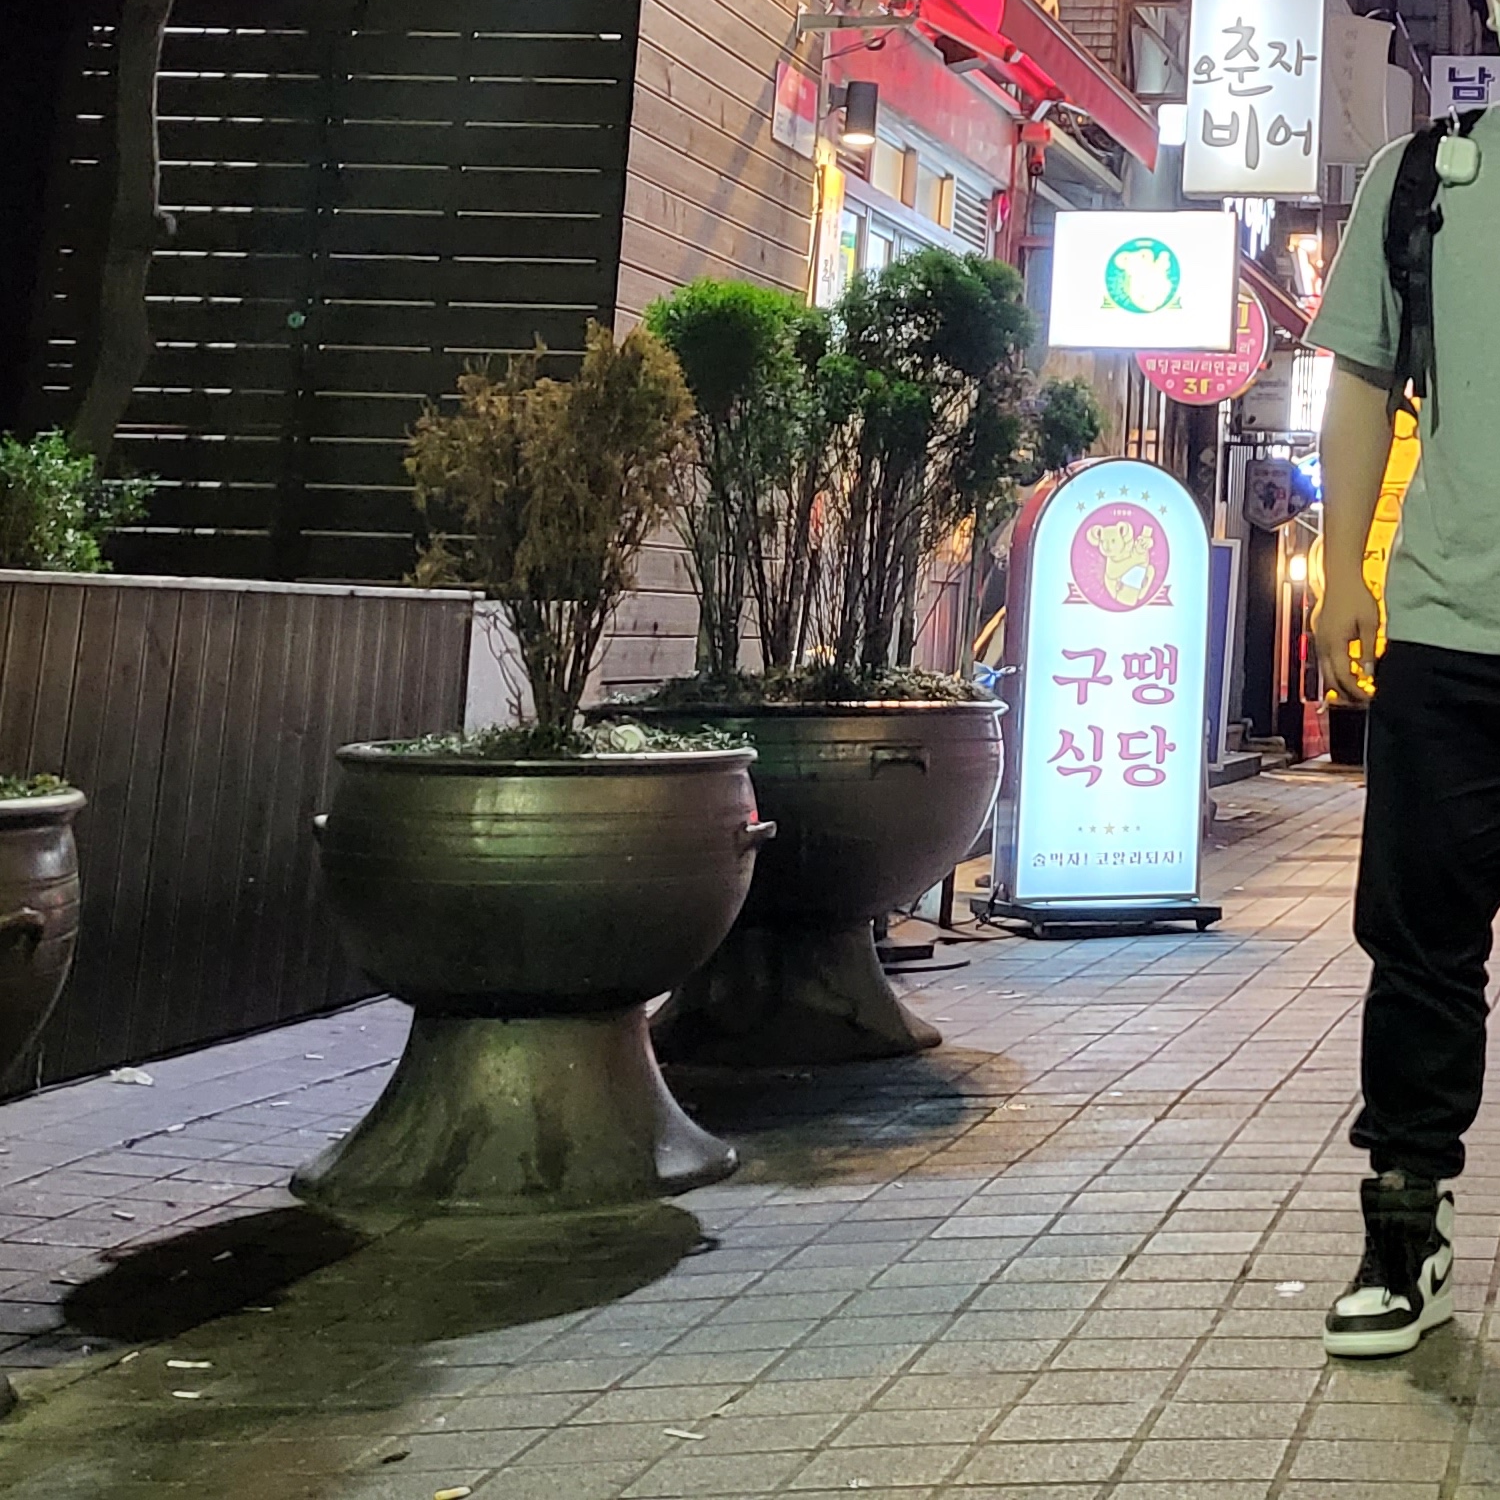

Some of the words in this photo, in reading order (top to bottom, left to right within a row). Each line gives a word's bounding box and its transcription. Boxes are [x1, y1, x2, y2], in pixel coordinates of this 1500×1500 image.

[1192, 16, 1318, 97] 오춘자
[1201, 103, 1313, 171] 비어
[1051, 642, 1180, 706] 구땡
[1046, 724, 1177, 788] 식당
